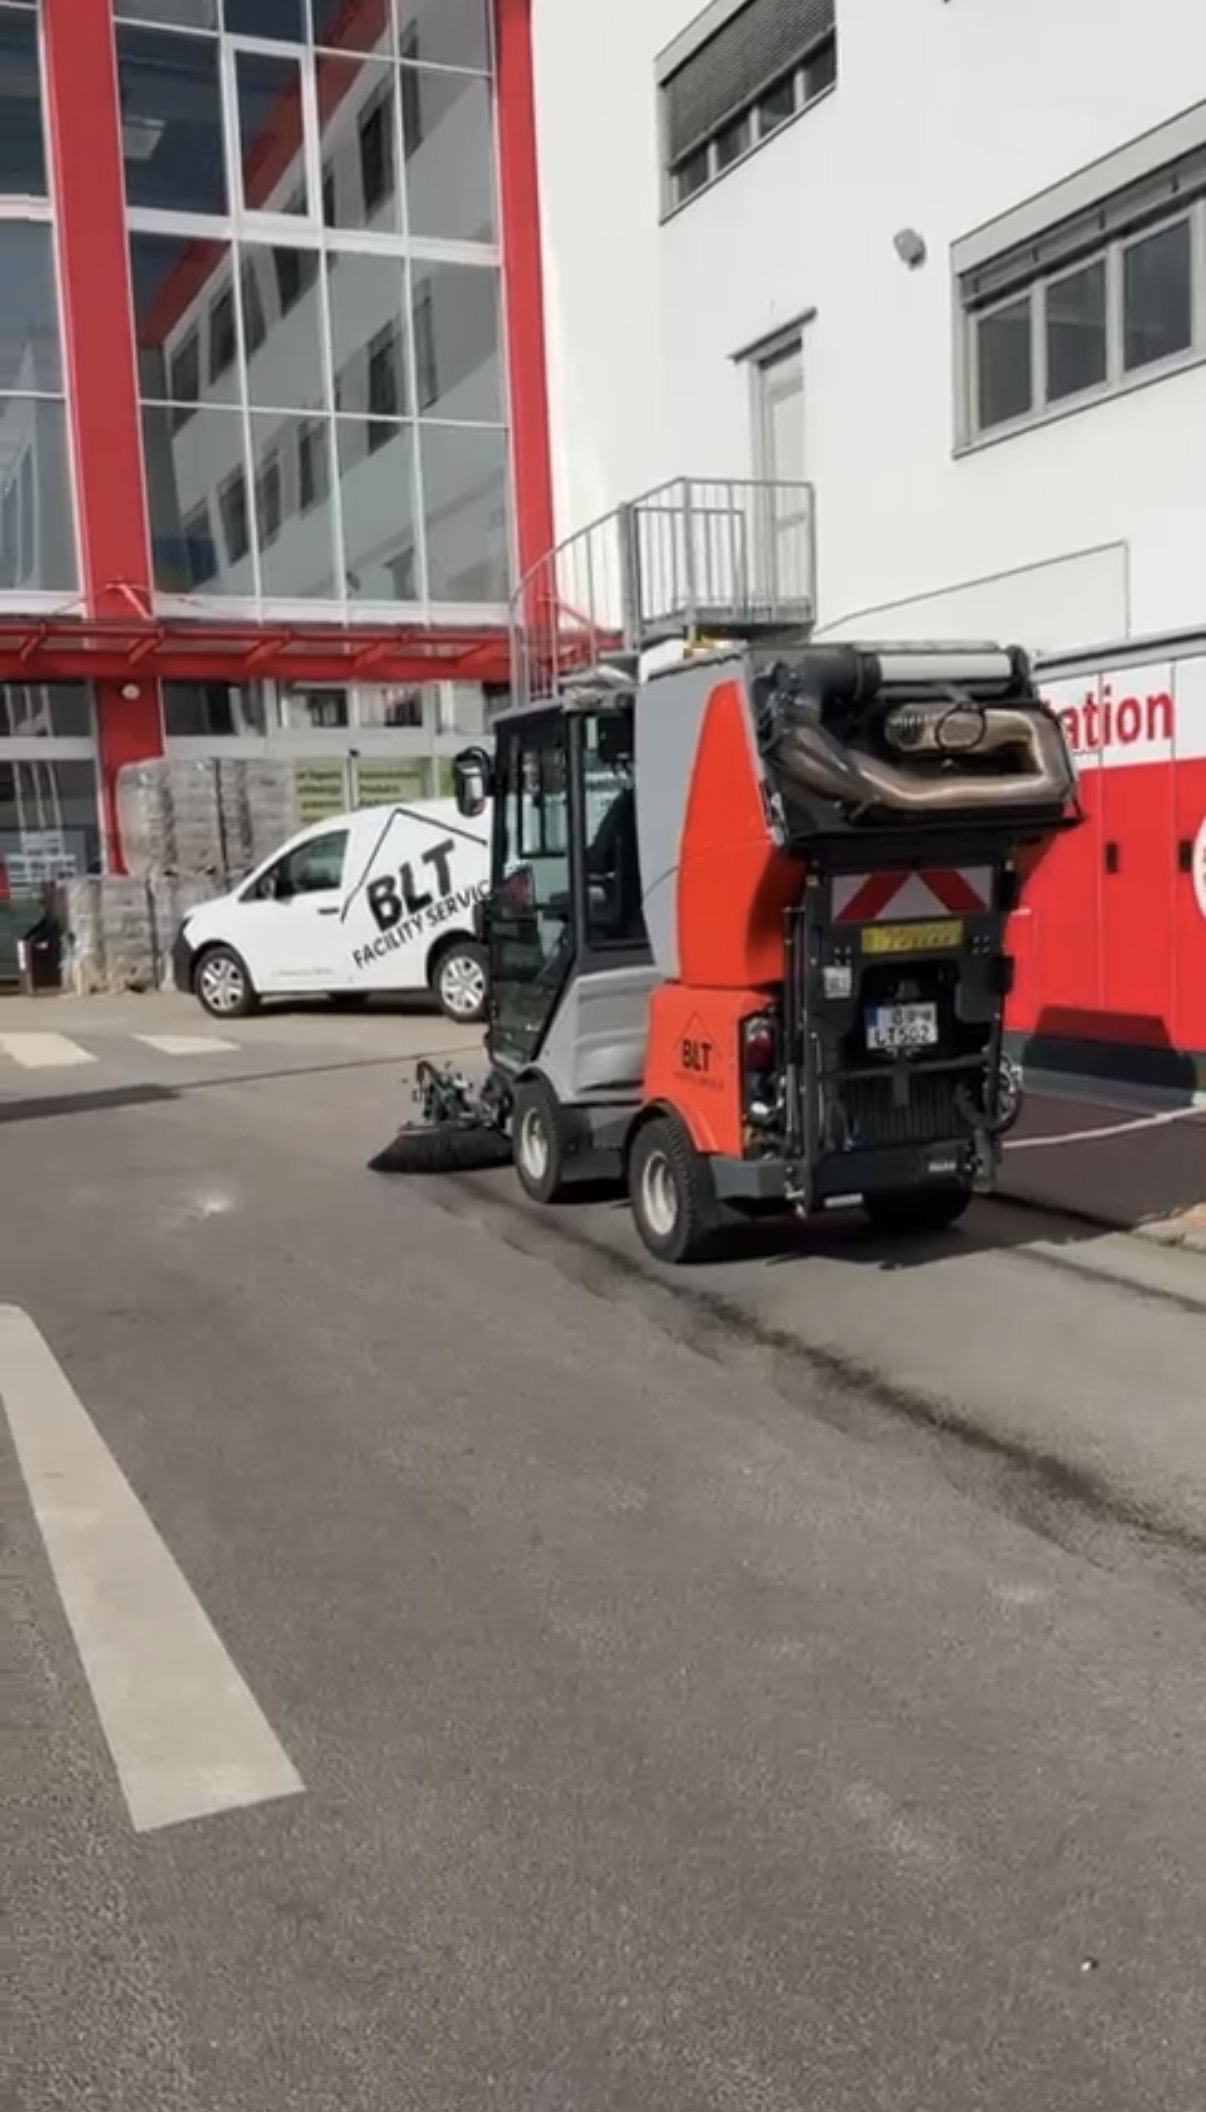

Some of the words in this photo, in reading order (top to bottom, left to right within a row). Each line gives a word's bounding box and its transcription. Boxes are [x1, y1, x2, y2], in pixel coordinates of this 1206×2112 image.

[1057, 684, 1174, 749] ation
[366, 838, 455, 932] BLT
[352, 913, 424, 969] FACILITY
[425, 879, 491, 927] SERVIC
[682, 1038, 712, 1072] BLT
